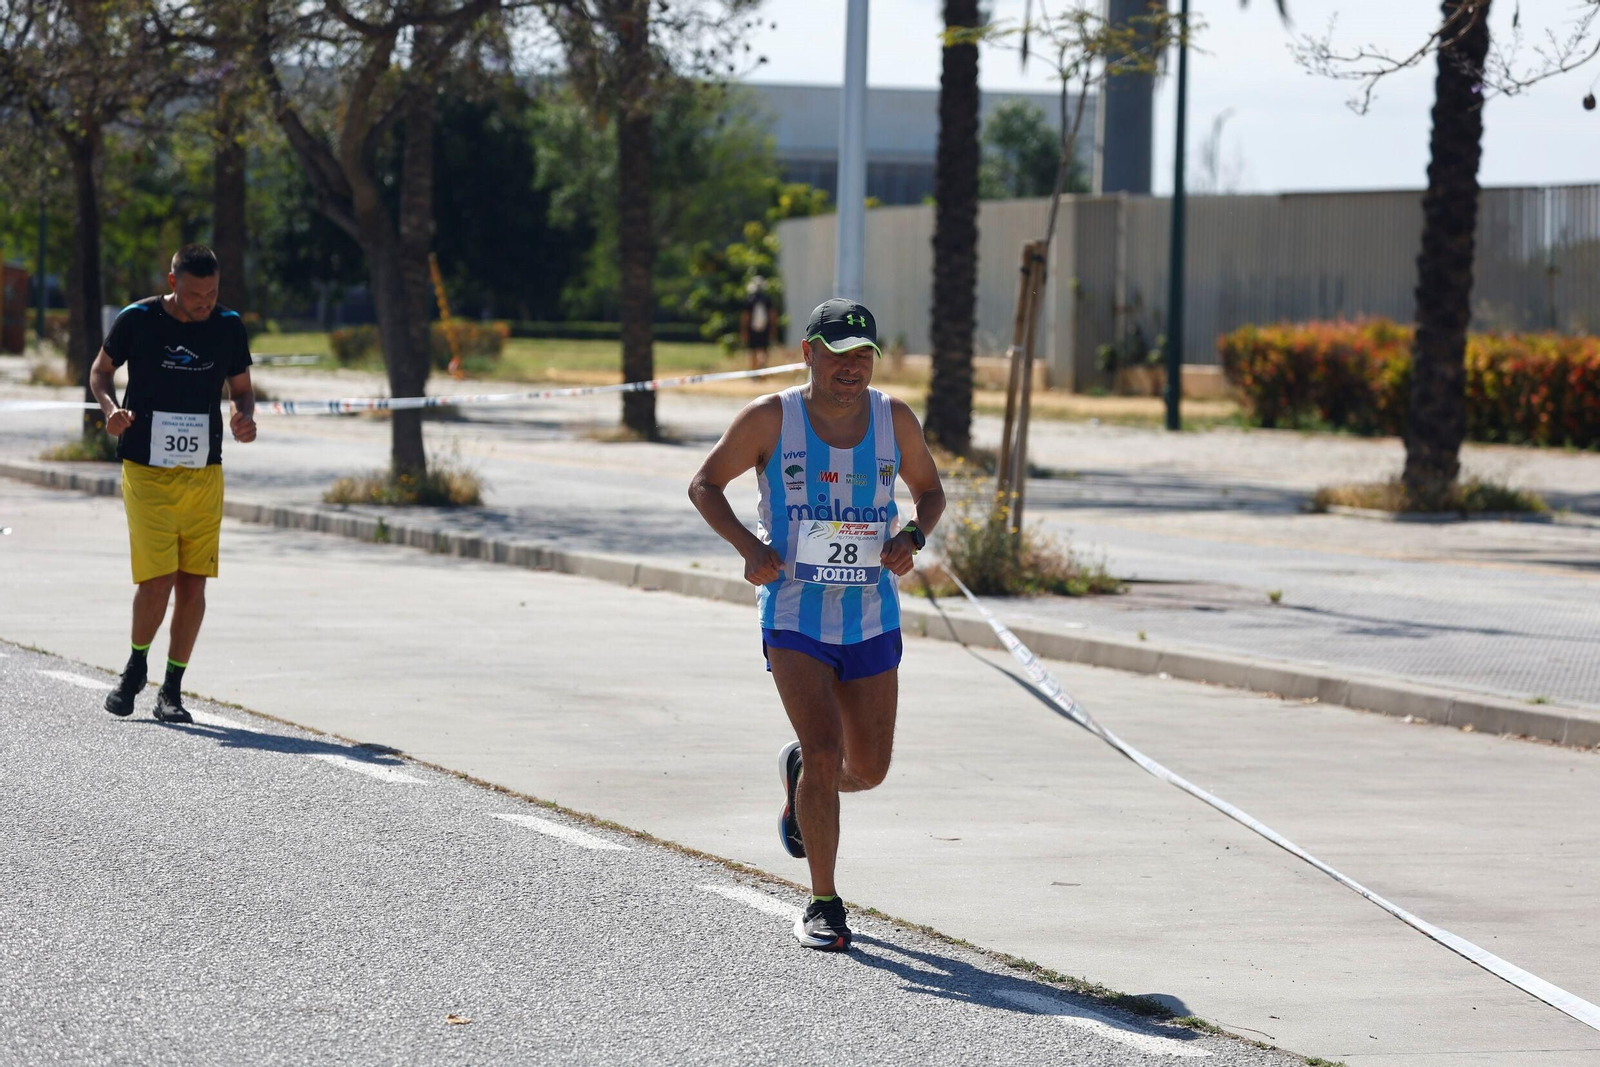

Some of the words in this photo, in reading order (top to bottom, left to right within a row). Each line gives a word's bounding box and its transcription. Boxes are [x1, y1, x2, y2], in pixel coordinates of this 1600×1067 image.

[164, 435, 198, 452] 305
[783, 450, 806, 460] vive
[828, 543, 858, 564] 28
